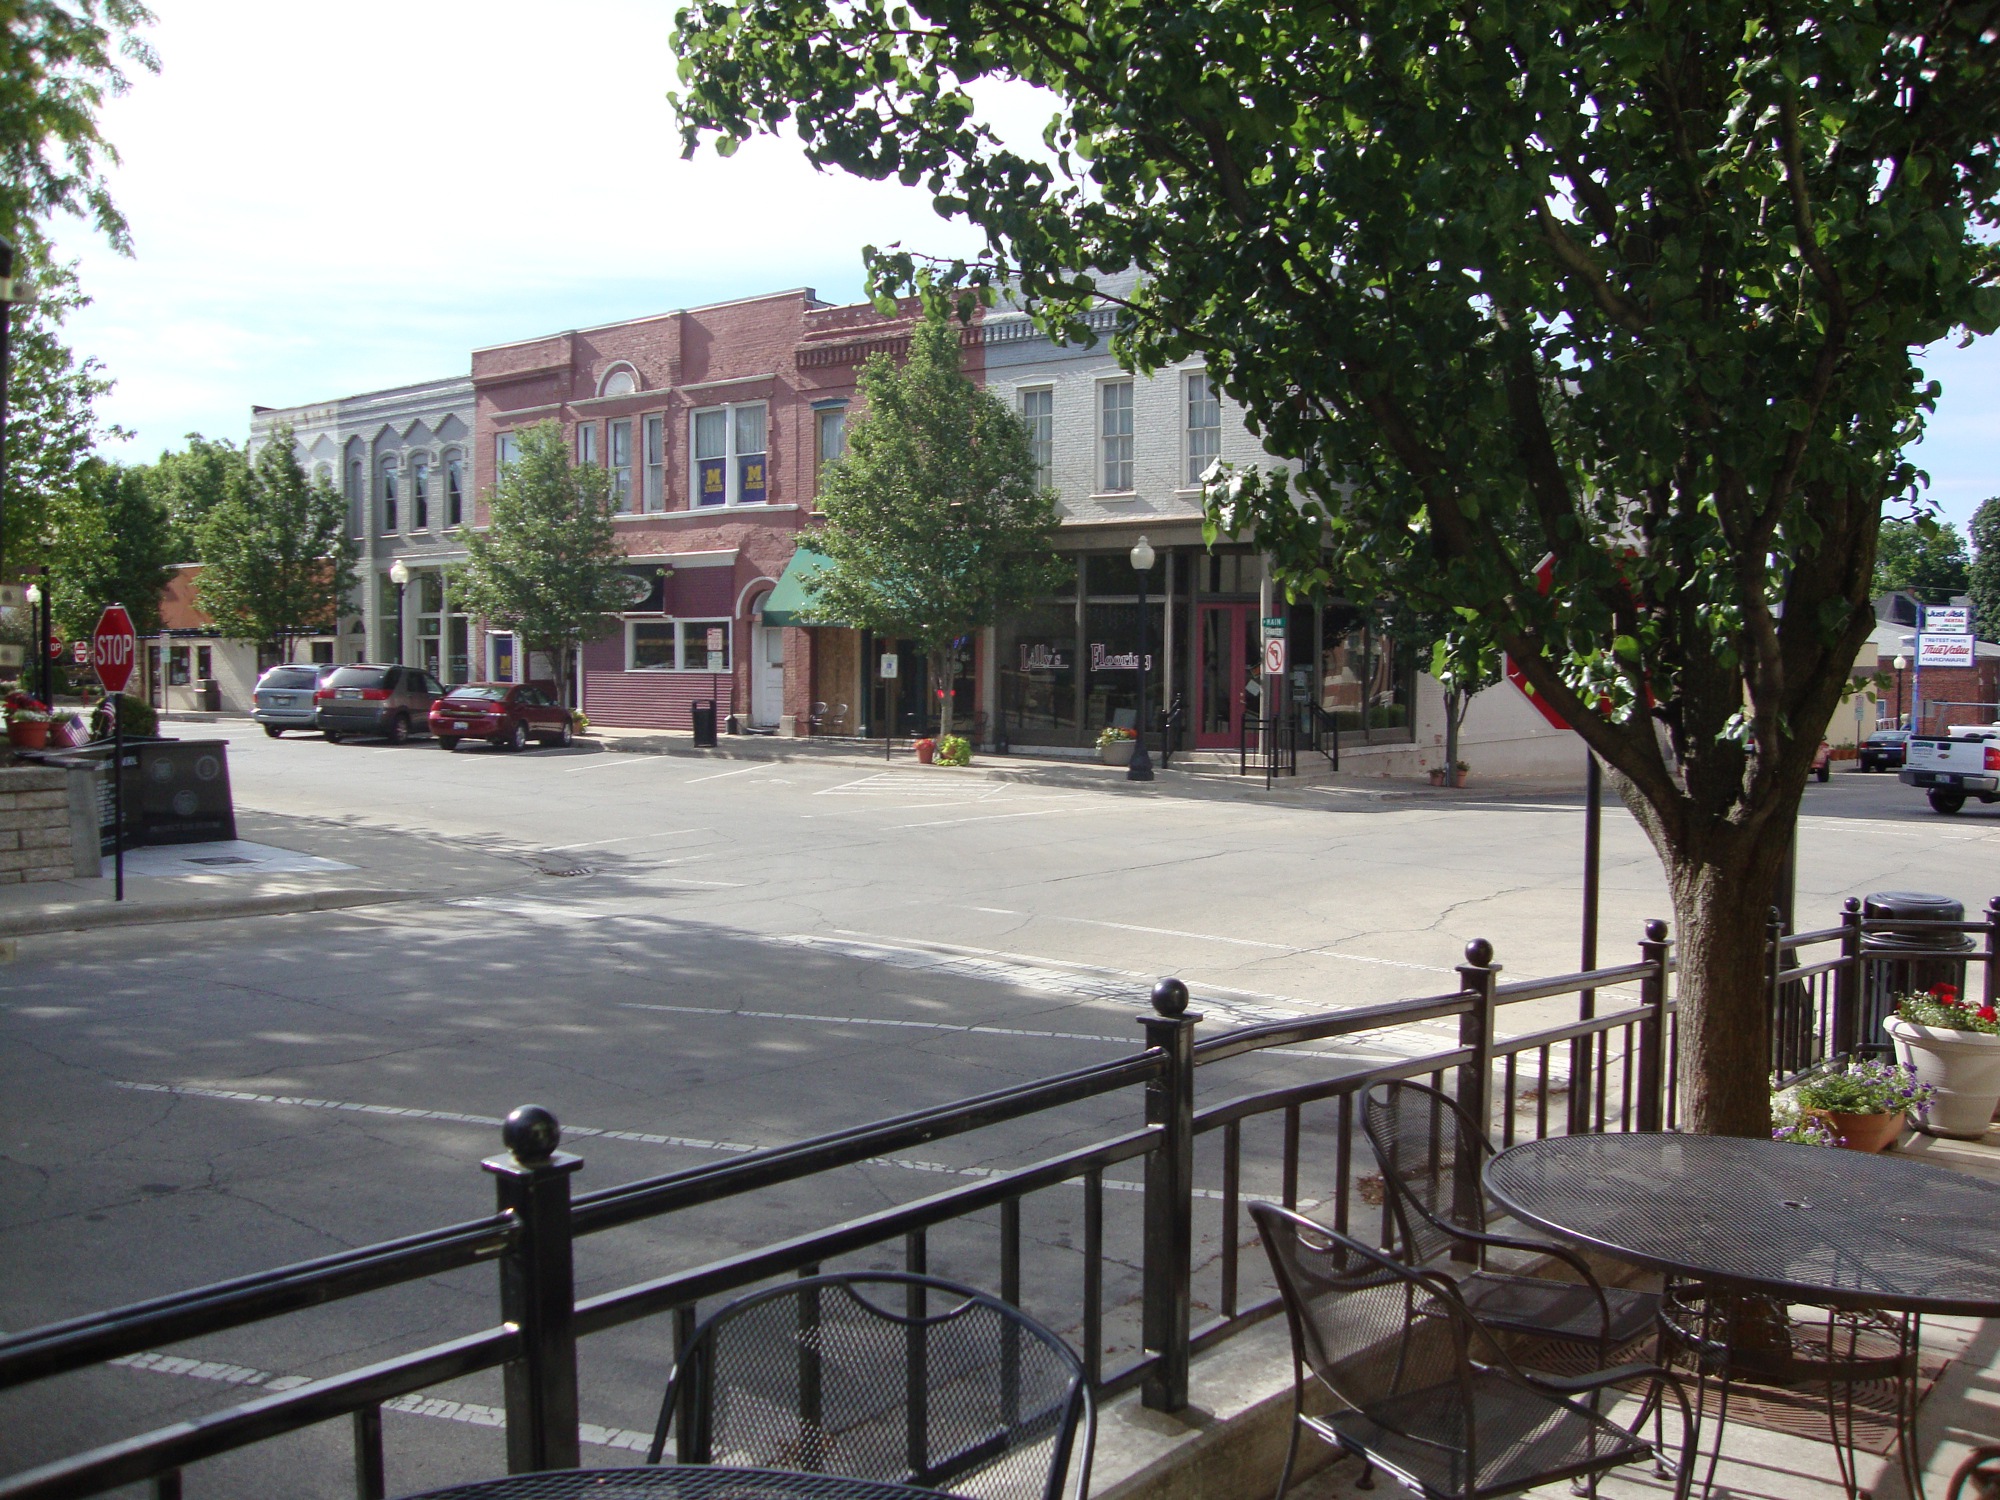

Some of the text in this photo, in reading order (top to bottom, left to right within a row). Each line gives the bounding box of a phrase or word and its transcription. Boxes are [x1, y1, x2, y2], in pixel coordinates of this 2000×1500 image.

[706, 468, 720, 485] M
[747, 465, 762, 481] M
[1266, 618, 1282, 626] MAIN
[97, 634, 133, 665] STOP
[1921, 644, 1969, 655] True Value
